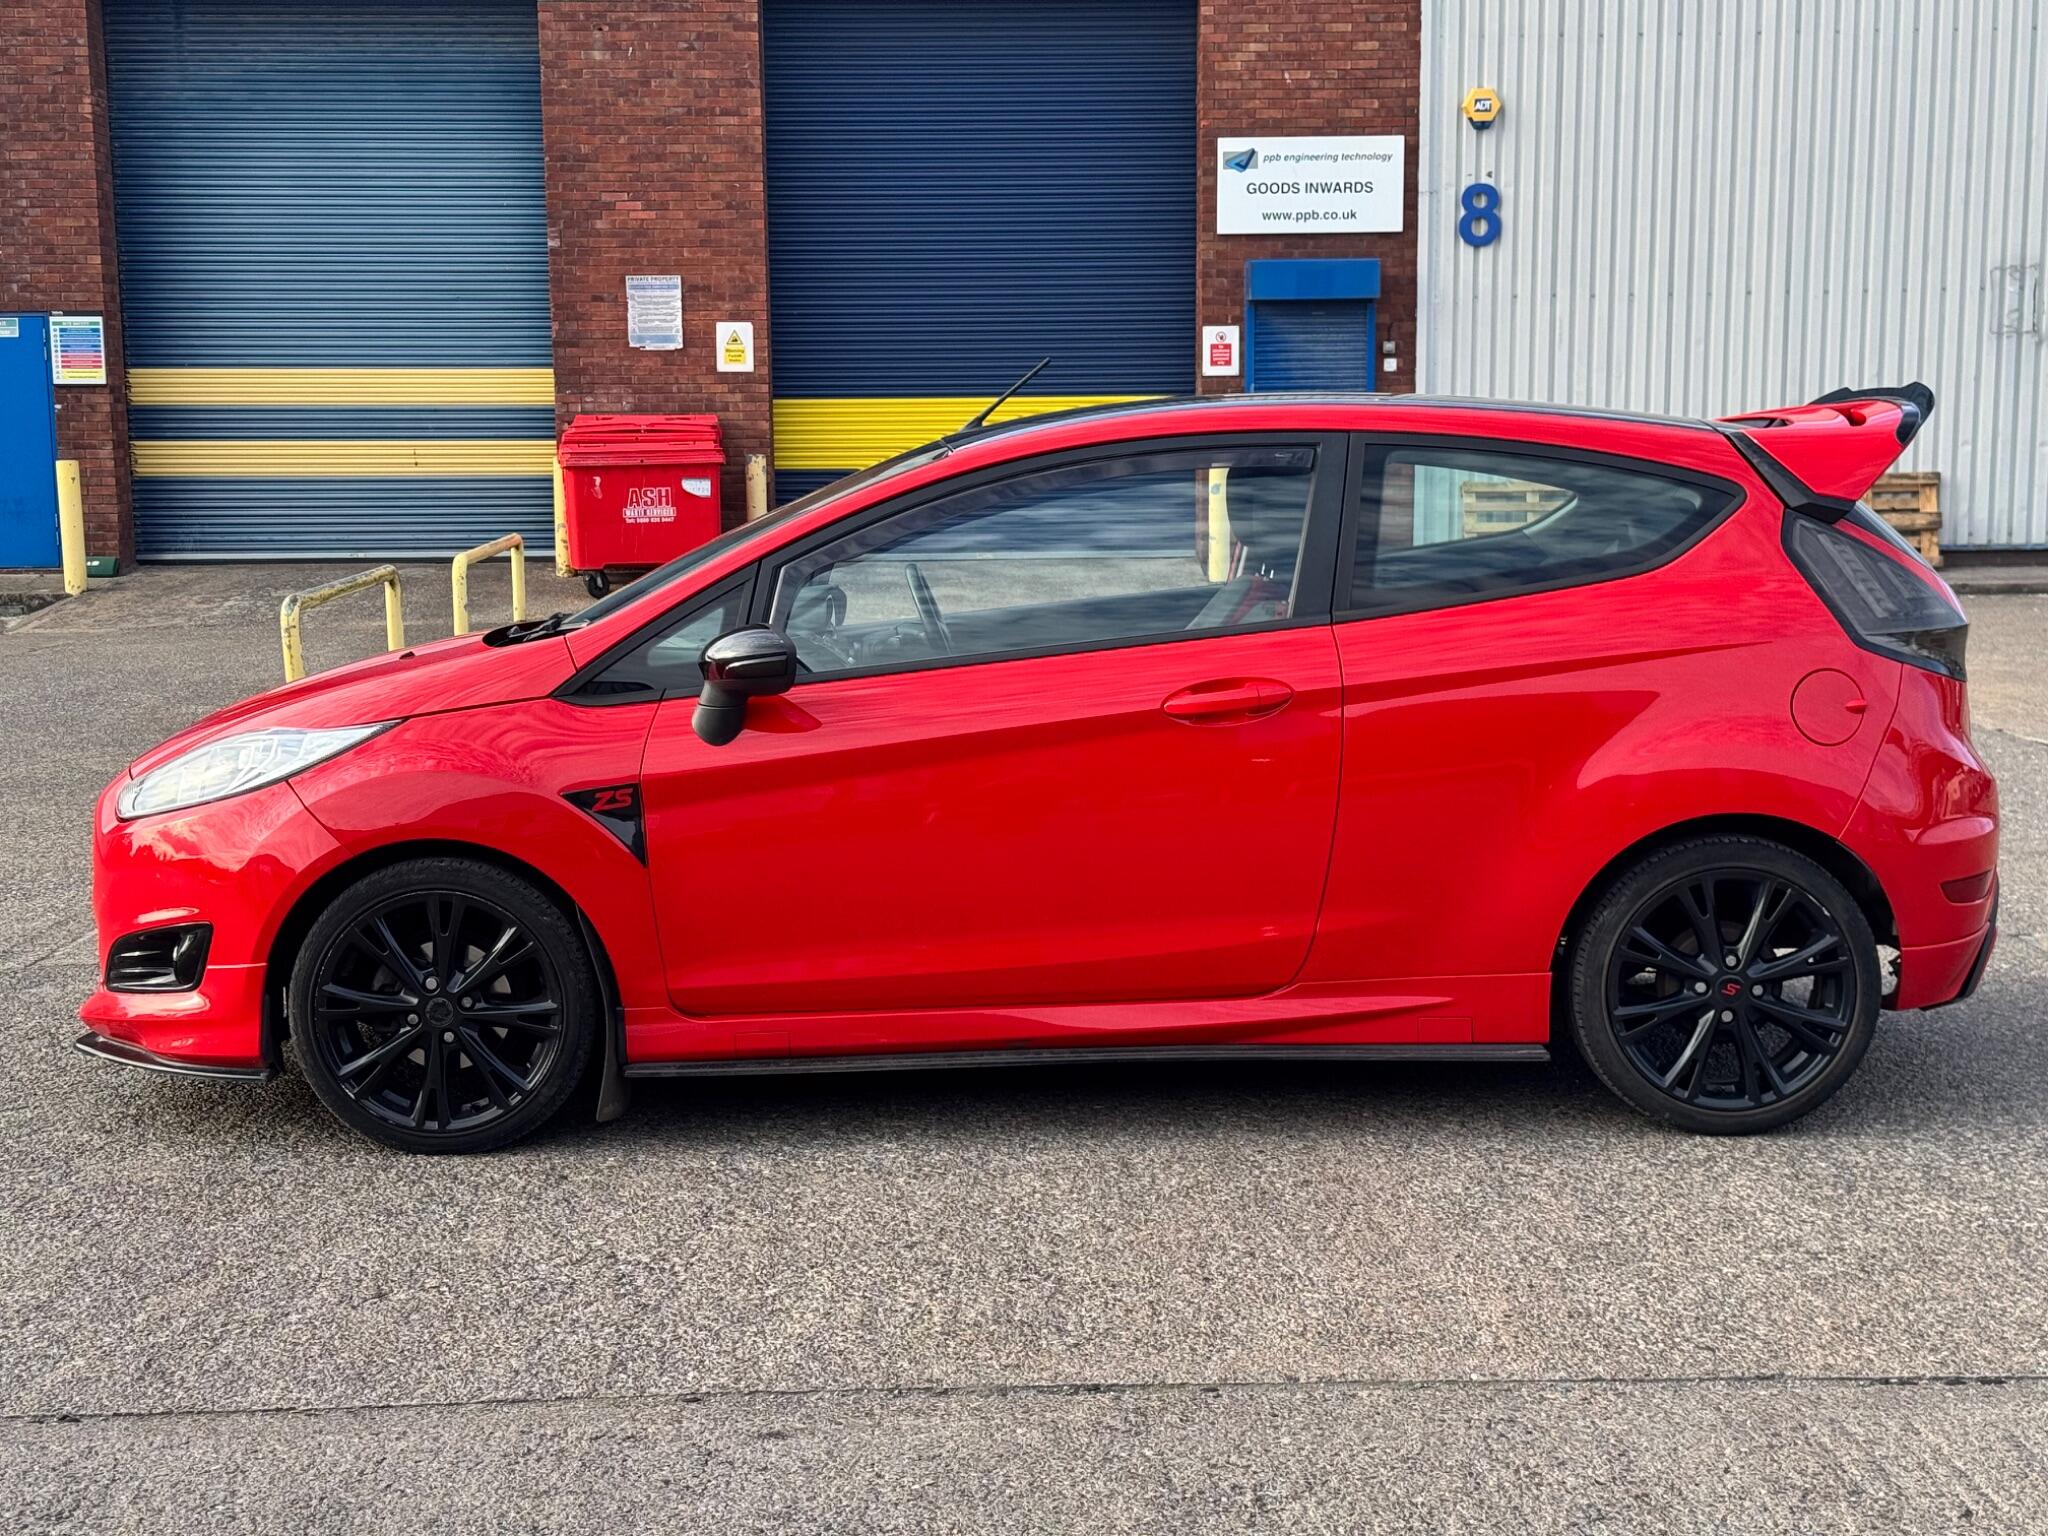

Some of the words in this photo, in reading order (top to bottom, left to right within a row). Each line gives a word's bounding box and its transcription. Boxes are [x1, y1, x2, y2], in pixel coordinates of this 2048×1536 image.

[1474, 100, 1491, 111] ADT
[1263, 154, 1282, 163] ppb
[1283, 153, 1339, 163] engineering
[1341, 152, 1393, 162] technology
[1246, 182, 1301, 195] GOODS
[1304, 181, 1374, 194] INWARDS
[1262, 209, 1358, 223] www.ppb.co.uk
[1459, 183, 1502, 248] 8
[628, 487, 672, 508] ASH
[592, 787, 634, 811] ZS
